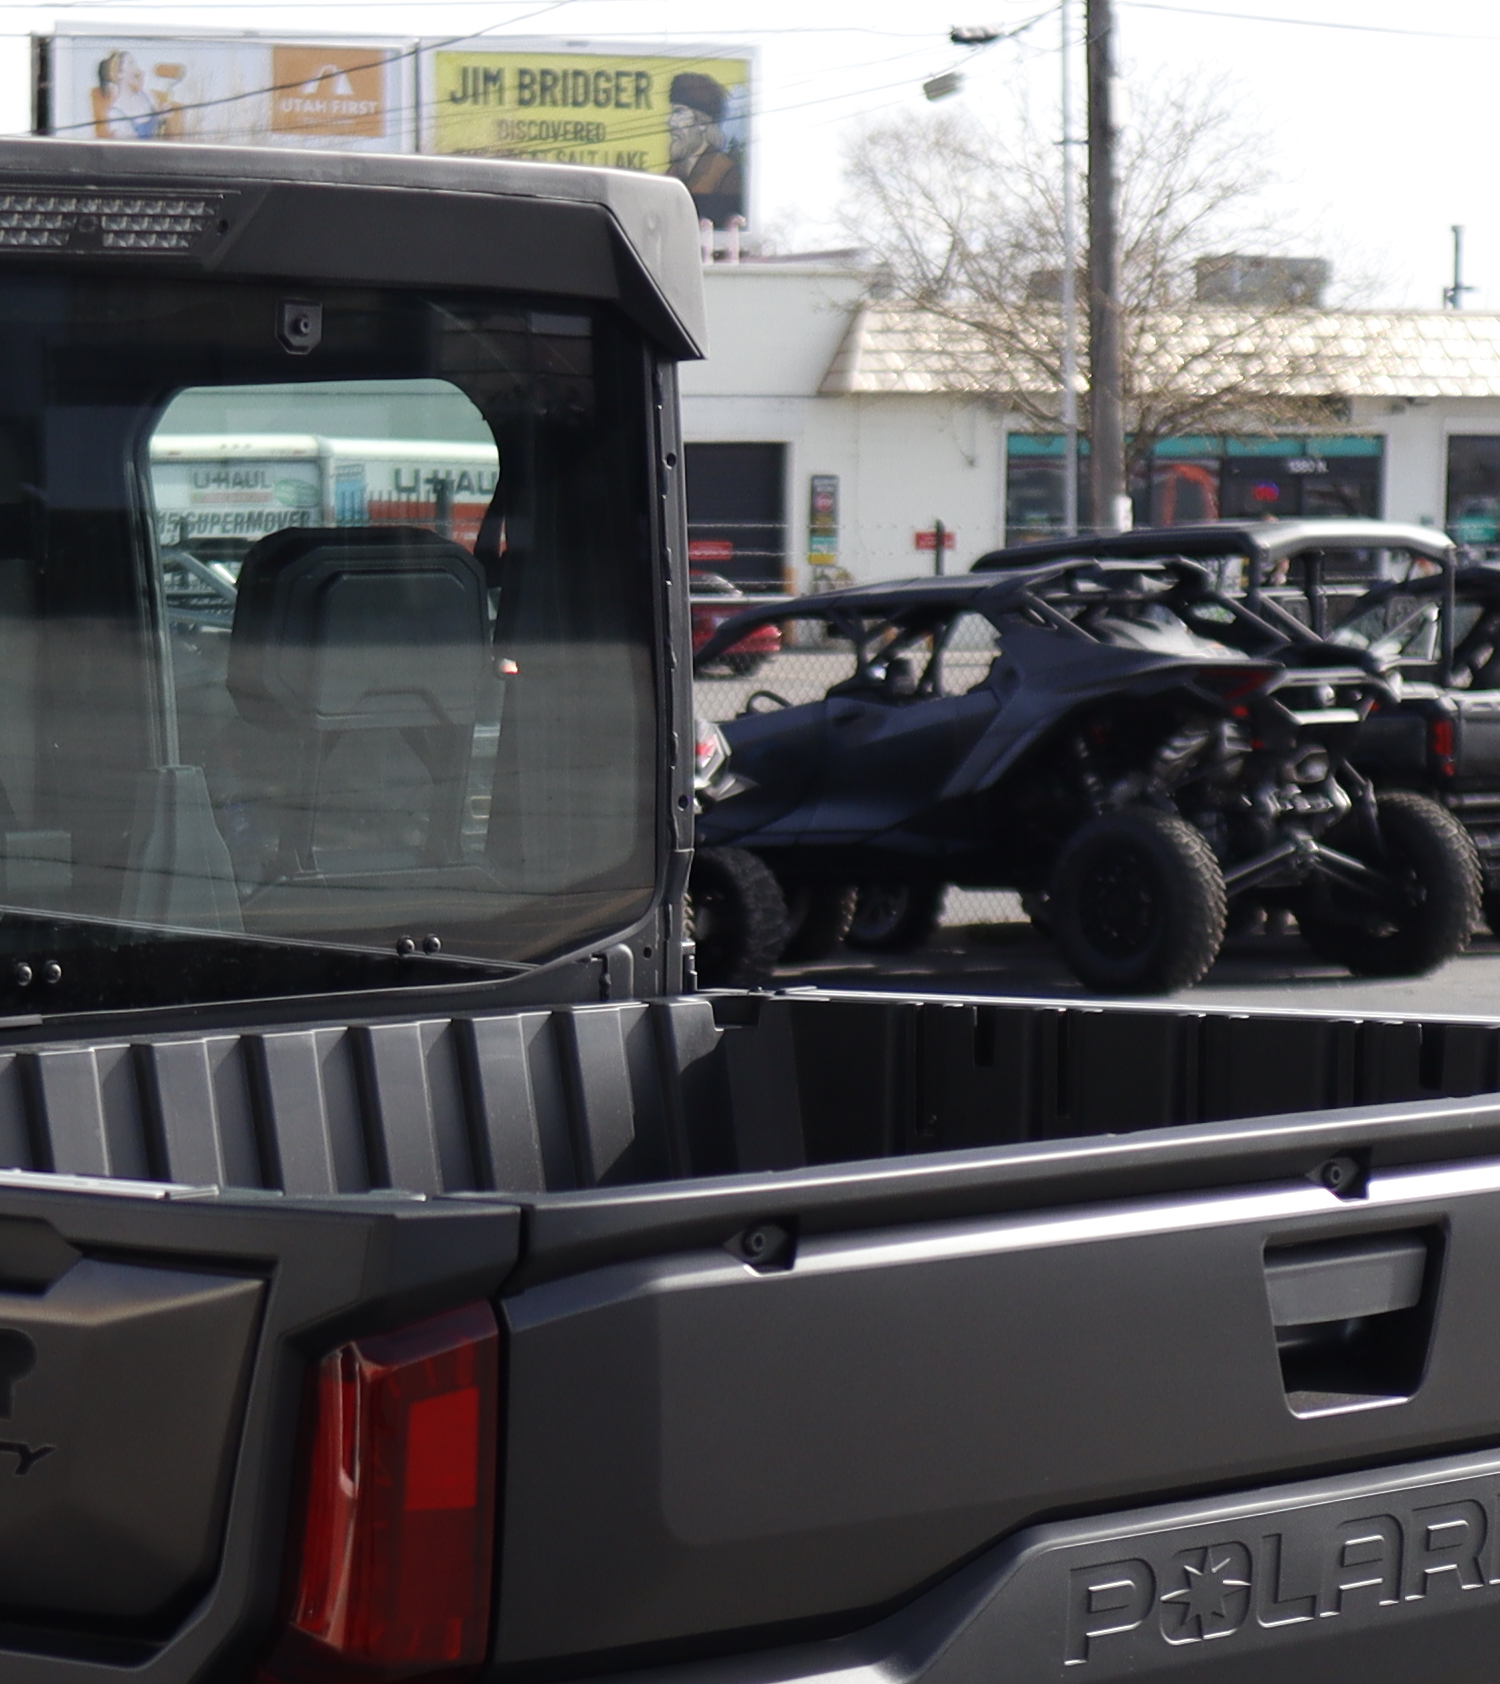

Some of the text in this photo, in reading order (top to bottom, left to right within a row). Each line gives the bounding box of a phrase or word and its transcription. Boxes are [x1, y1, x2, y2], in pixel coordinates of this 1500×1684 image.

[450, 66, 653, 110] JIM BRIDGER
[280, 98, 378, 115] UTAH FIRST
[497, 119, 606, 143] DISCOVERED
[193, 470, 272, 489] U-HAUL
[394, 468, 497, 496] U-HAU
[183, 509, 311, 535] SUPERMOVER
